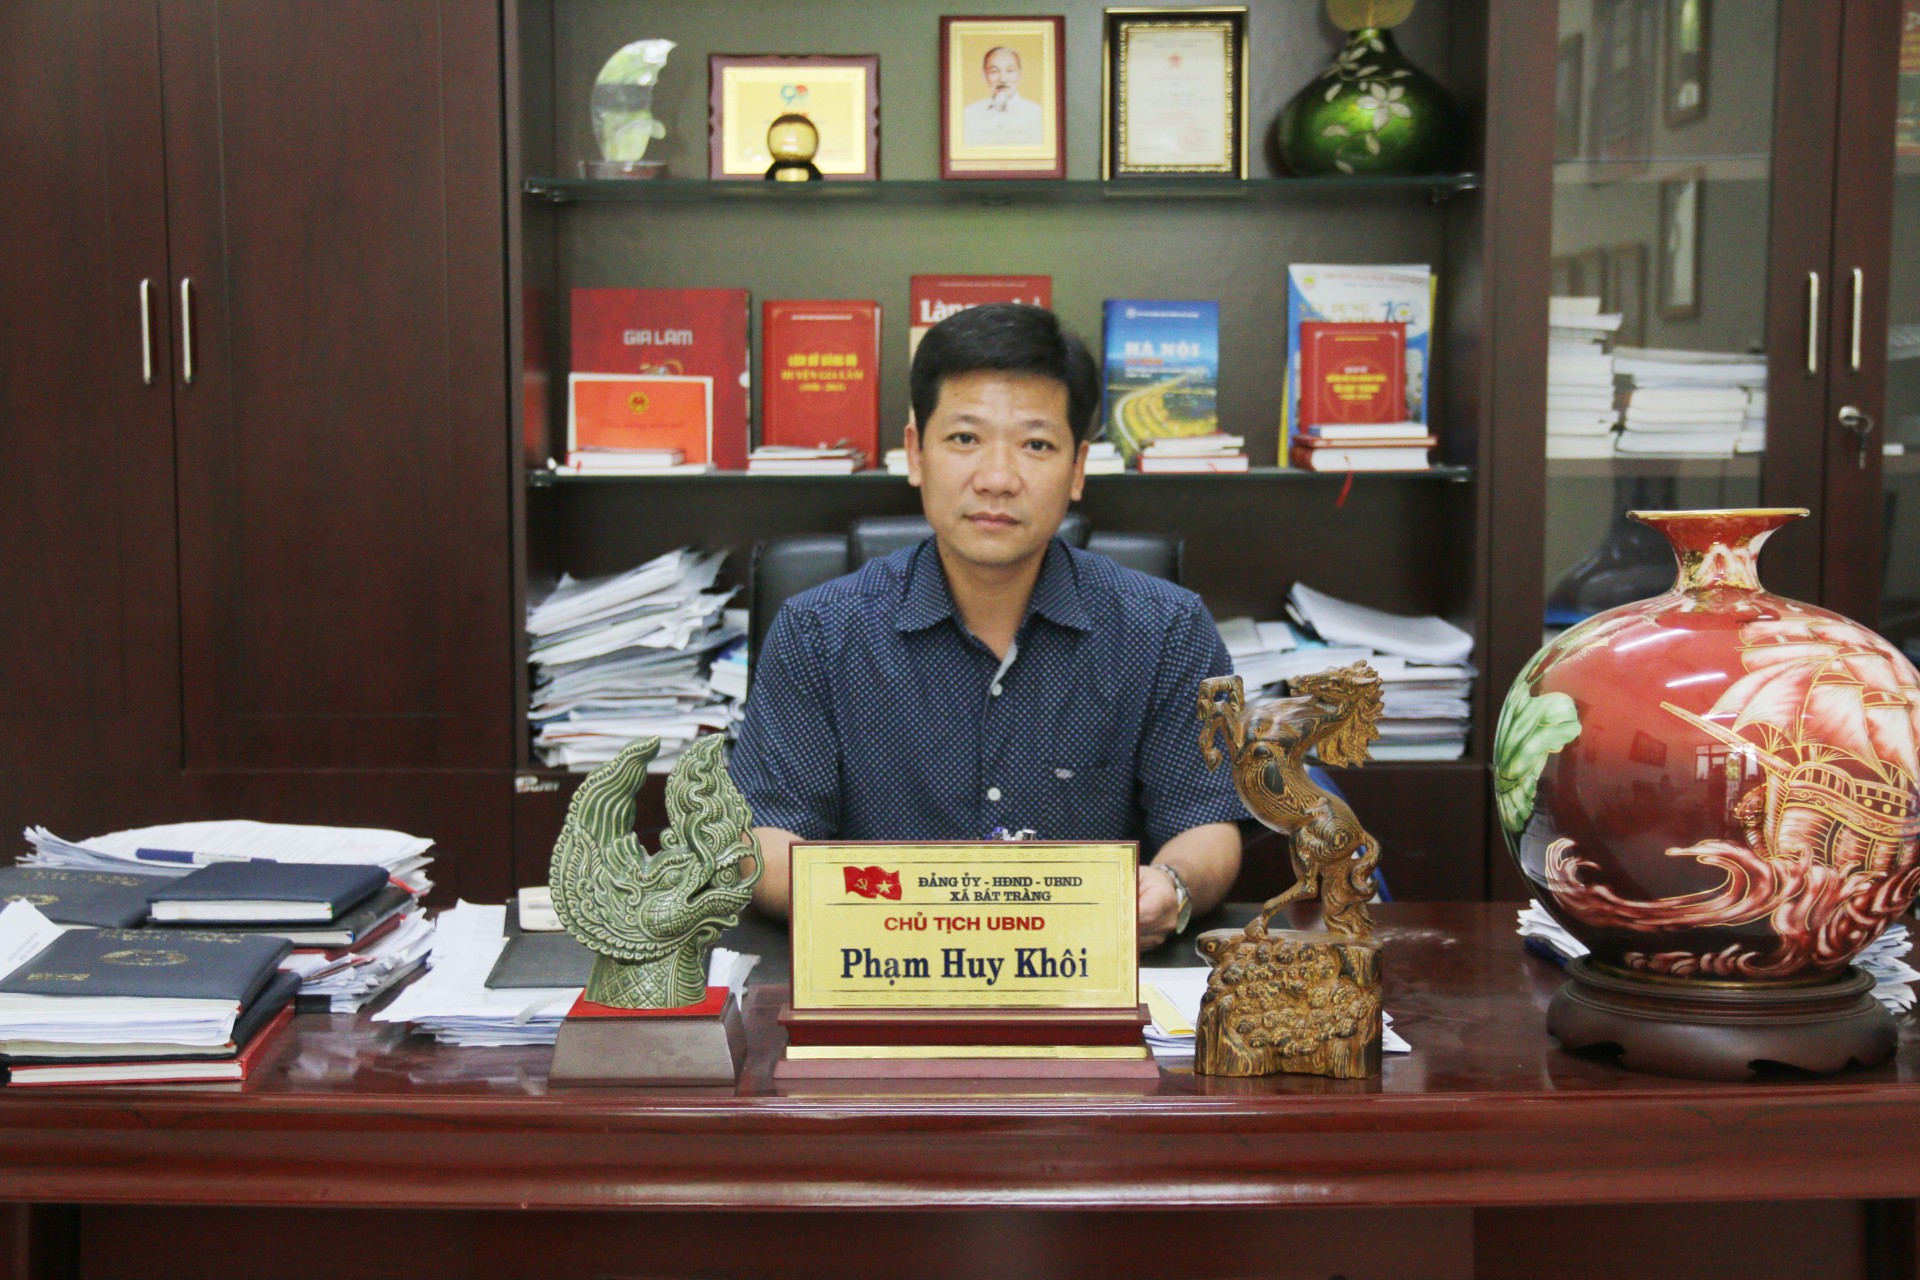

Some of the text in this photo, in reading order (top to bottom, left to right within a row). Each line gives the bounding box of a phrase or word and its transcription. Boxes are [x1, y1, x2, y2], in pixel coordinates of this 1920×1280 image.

[918, 872, 959, 888] ĐẢNG
[962, 872, 982, 888] ỦY
[992, 876, 1033, 888] HĐND
[1043, 876, 1083, 888] UBND
[949, 887, 1052, 902] XÃ BÁT TRÀNG
[884, 911, 1046, 935] CHỦ TỊCH UBND
[840, 947, 1089, 986] Phạm Huy Khôi
